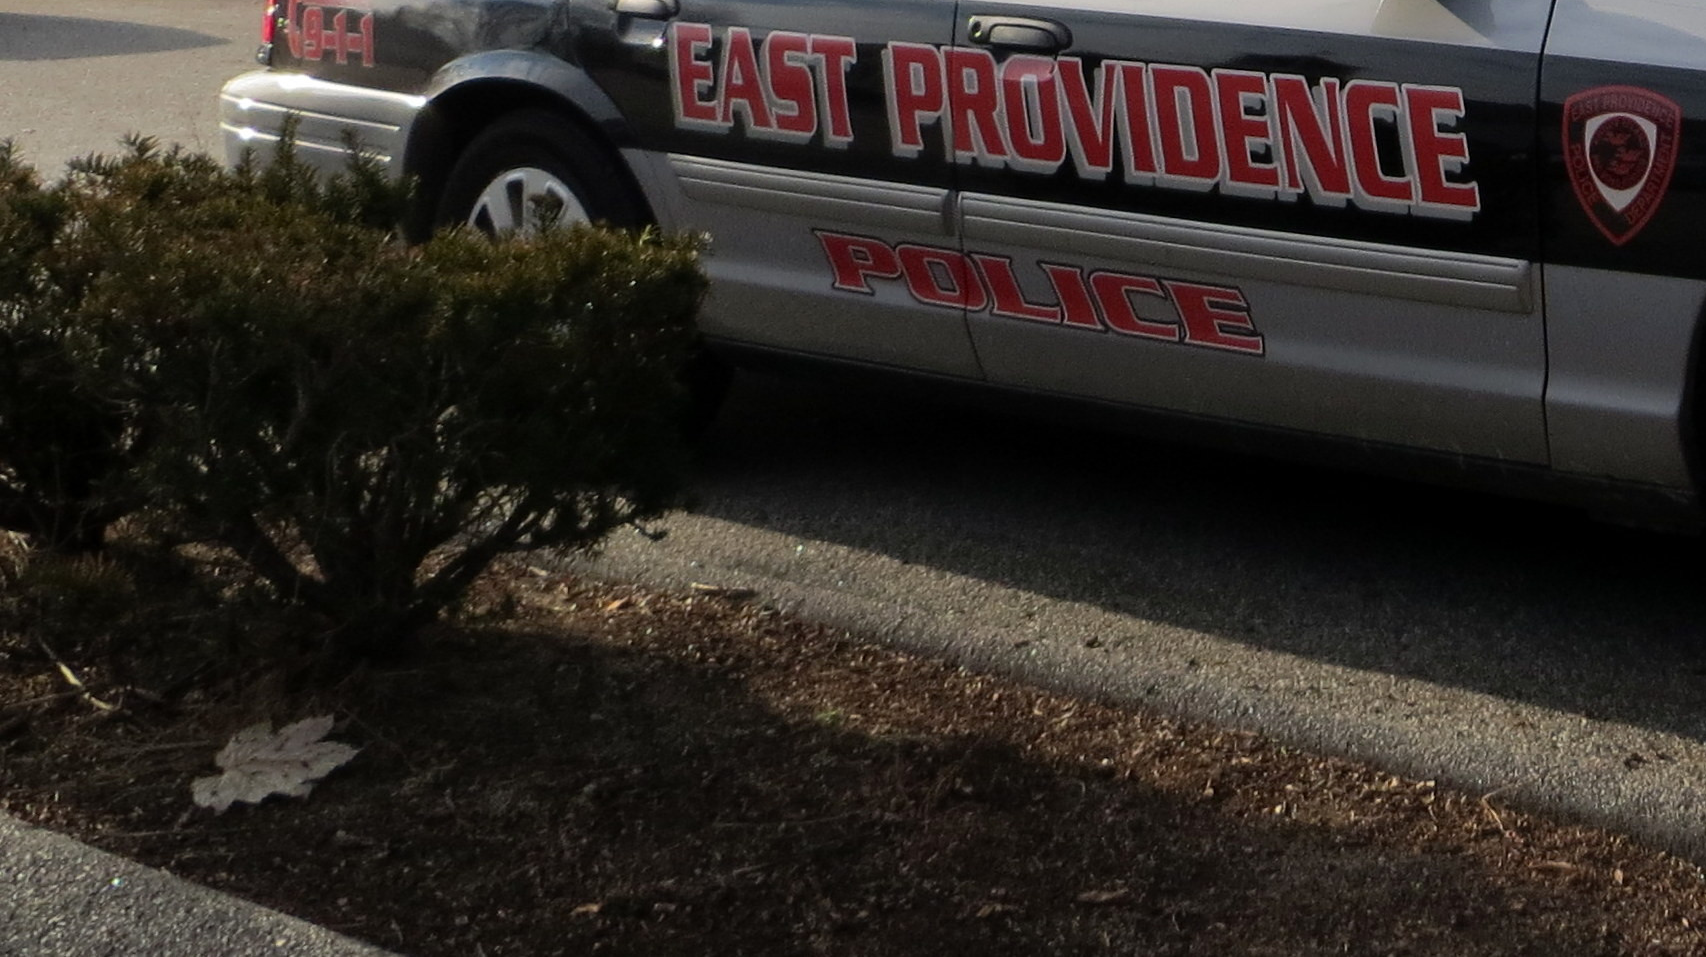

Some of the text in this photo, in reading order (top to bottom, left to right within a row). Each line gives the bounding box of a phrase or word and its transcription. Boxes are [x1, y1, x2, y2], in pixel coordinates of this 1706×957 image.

[667, 21, 1480, 222] EAST PROVIDENCE
[1571, 94, 1676, 127] EAST PROVIDENCE
[1571, 143, 1599, 207] POLICE
[1624, 130, 1673, 225] DEPARTMENT
[812, 229, 1265, 355] POLICE
